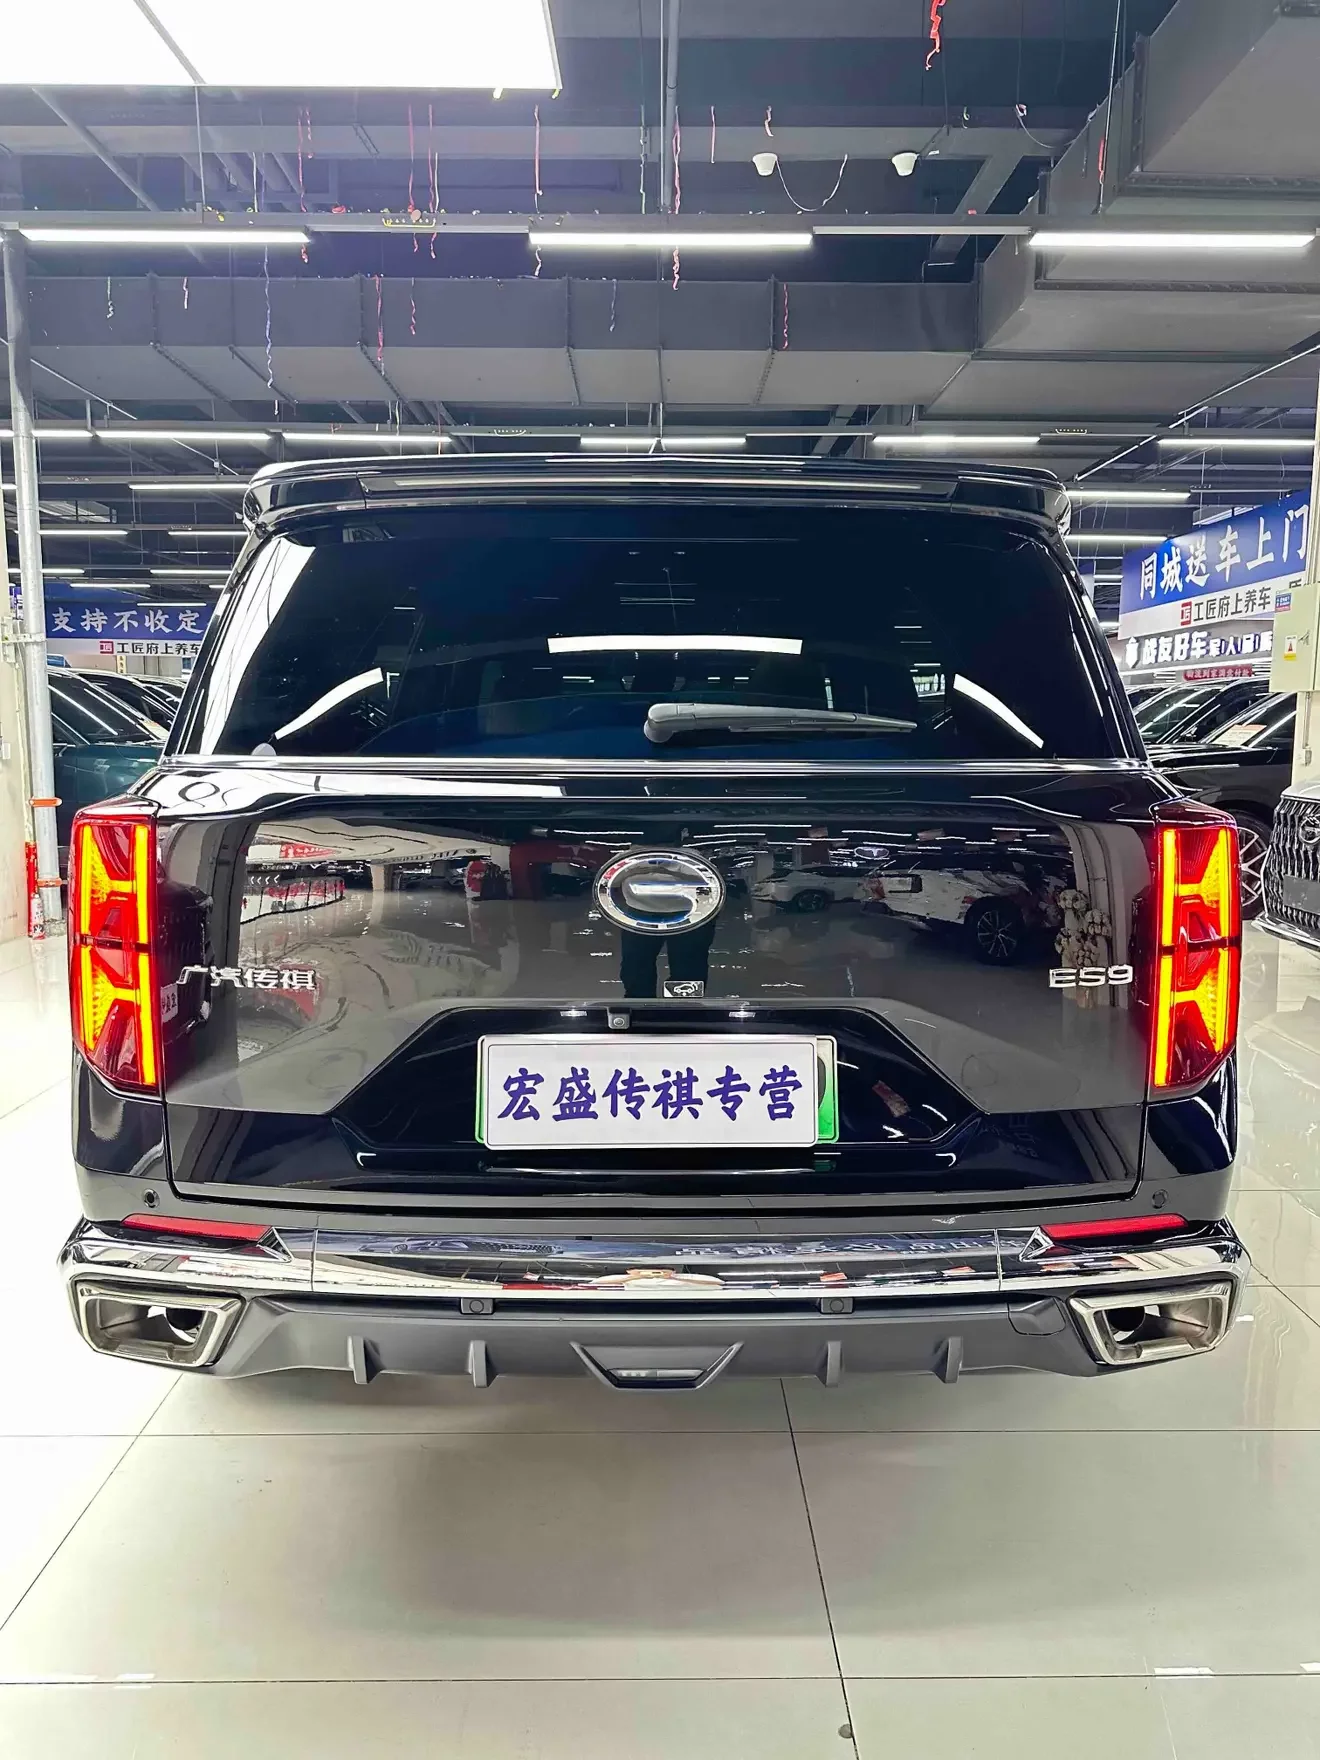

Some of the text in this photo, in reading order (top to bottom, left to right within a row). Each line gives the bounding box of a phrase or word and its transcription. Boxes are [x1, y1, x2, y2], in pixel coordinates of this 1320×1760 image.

[1140, 504, 1309, 600] 同城送车上门
[1193, 586, 1271, 621] 工匠府上养车
[52, 607, 204, 633] 支持不收定
[117, 642, 201, 655] 工匠府上养车
[1142, 631, 1208, 665] 战友好车
[176, 965, 315, 990] 广汽传祺
[1049, 964, 1133, 988] ES9
[497, 1065, 802, 1121] 宏盛传祺专营
